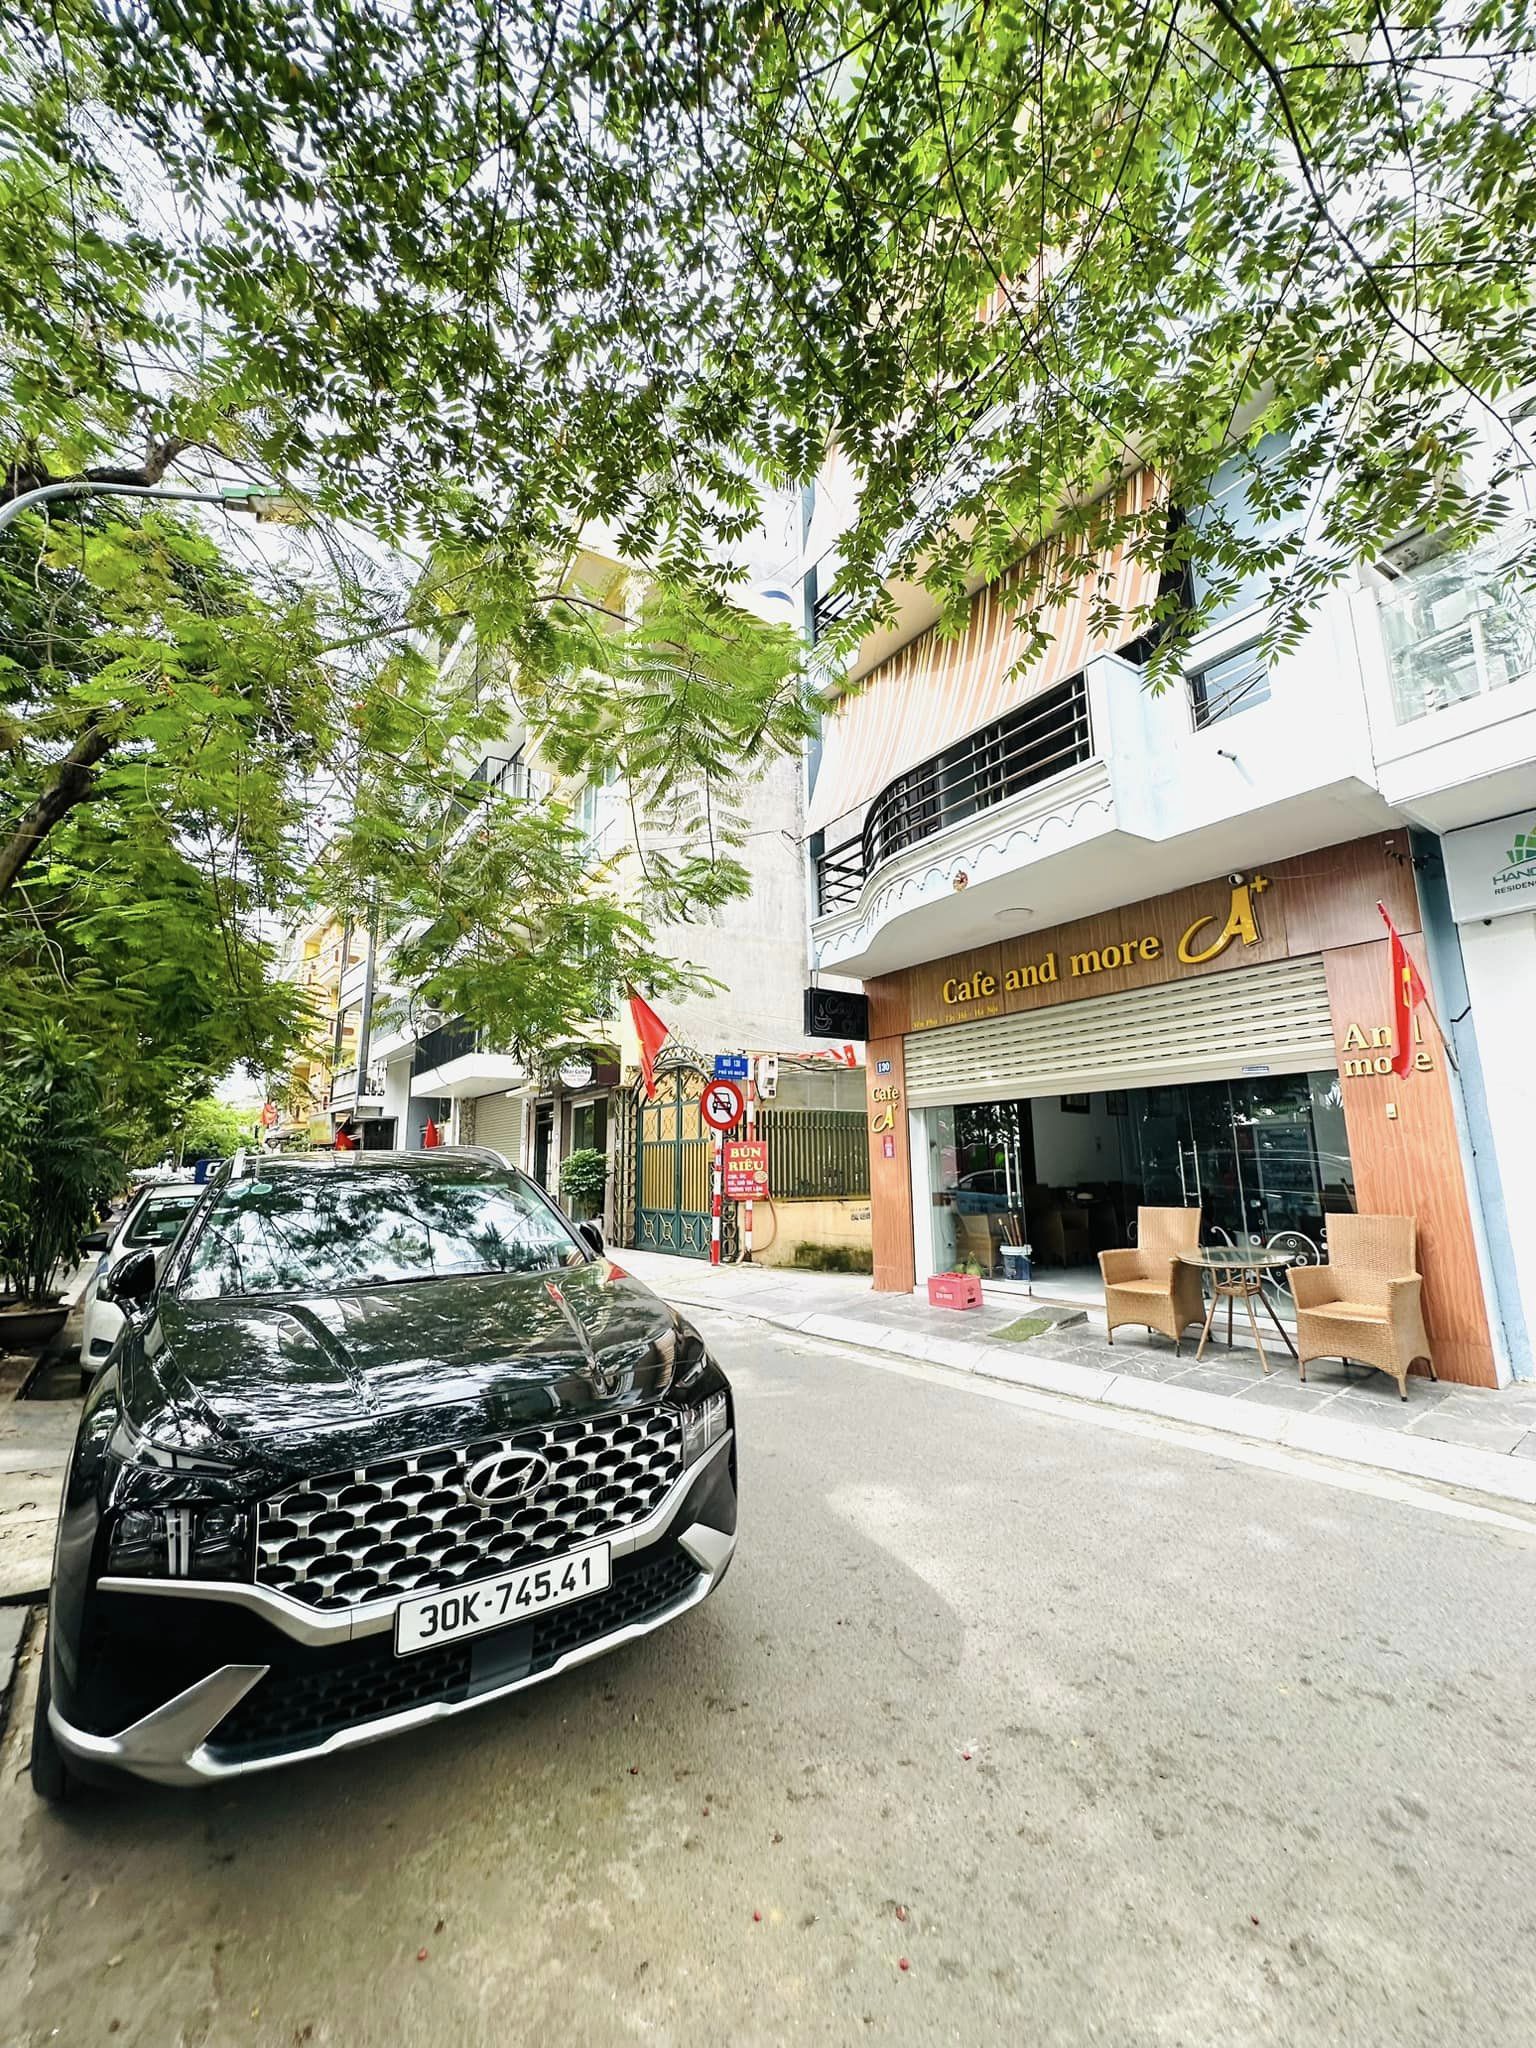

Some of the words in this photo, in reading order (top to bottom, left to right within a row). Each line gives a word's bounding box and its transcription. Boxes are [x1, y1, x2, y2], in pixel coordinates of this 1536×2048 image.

[1495, 880, 1536, 895] RESIDEN
[942, 971, 995, 1004] Cafe
[1005, 953, 1058, 992] and
[1070, 935, 1161, 976] more
[878, 1062, 890, 1073] 130
[1344, 1051, 1434, 1077] moe
[872, 1085, 900, 1102] Cafe
[730, 1145, 761, 1158] BÚN
[728, 1158, 764, 1171] RIÊU
[419, 1557, 591, 1638] 30K-745.41
